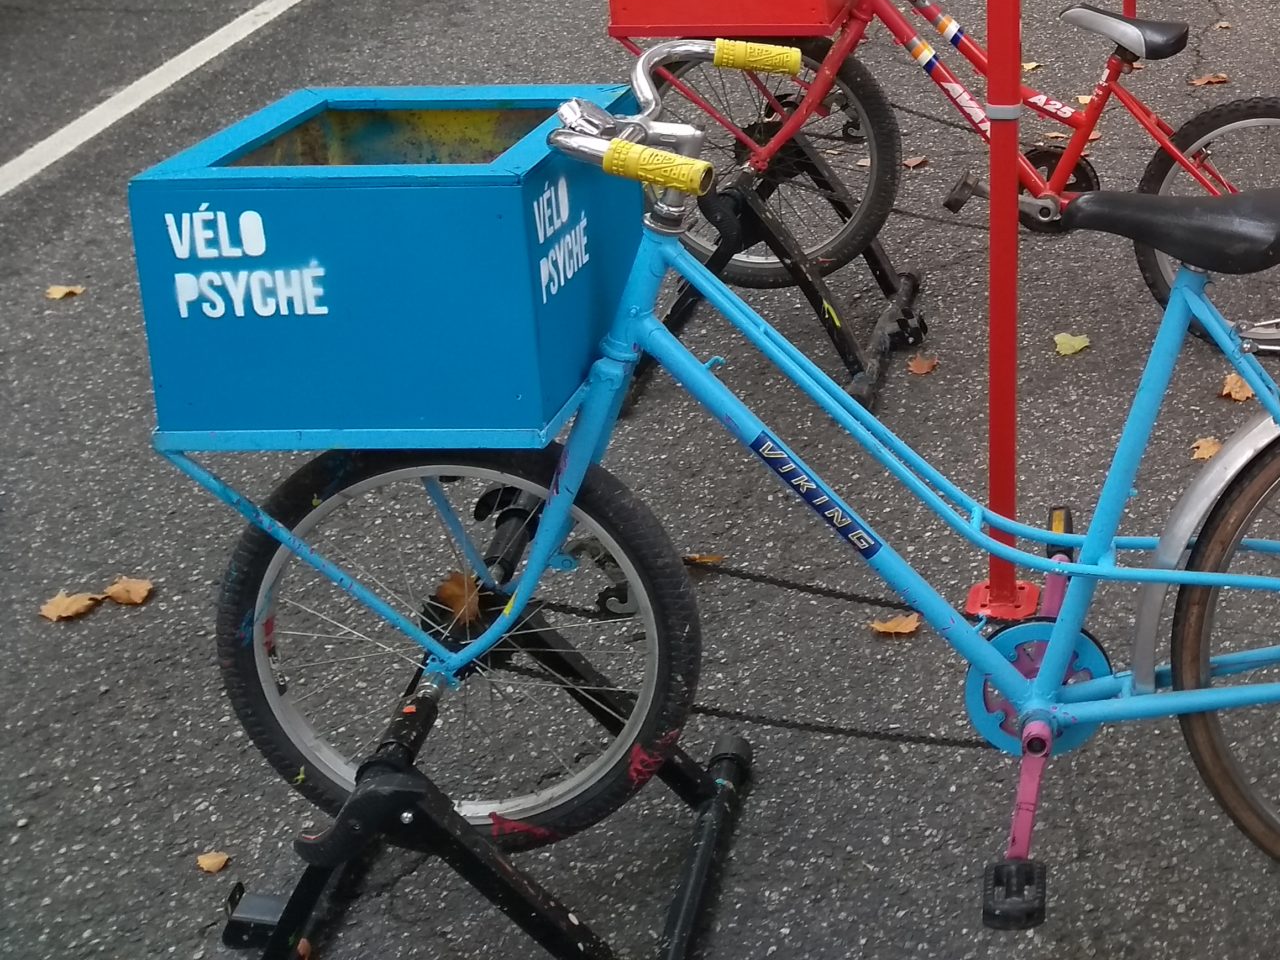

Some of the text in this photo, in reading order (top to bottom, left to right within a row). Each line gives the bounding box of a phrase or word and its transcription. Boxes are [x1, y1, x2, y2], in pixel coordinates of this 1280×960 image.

[1027, 94, 1076, 118] A25
[164, 202, 266, 259] VÉLO
[533, 176, 569, 244] VÉLO
[174, 258, 329, 318] PSYCHÉ
[539, 210, 590, 305] PSYCHÉ
[759, 440, 875, 550] VIKING
